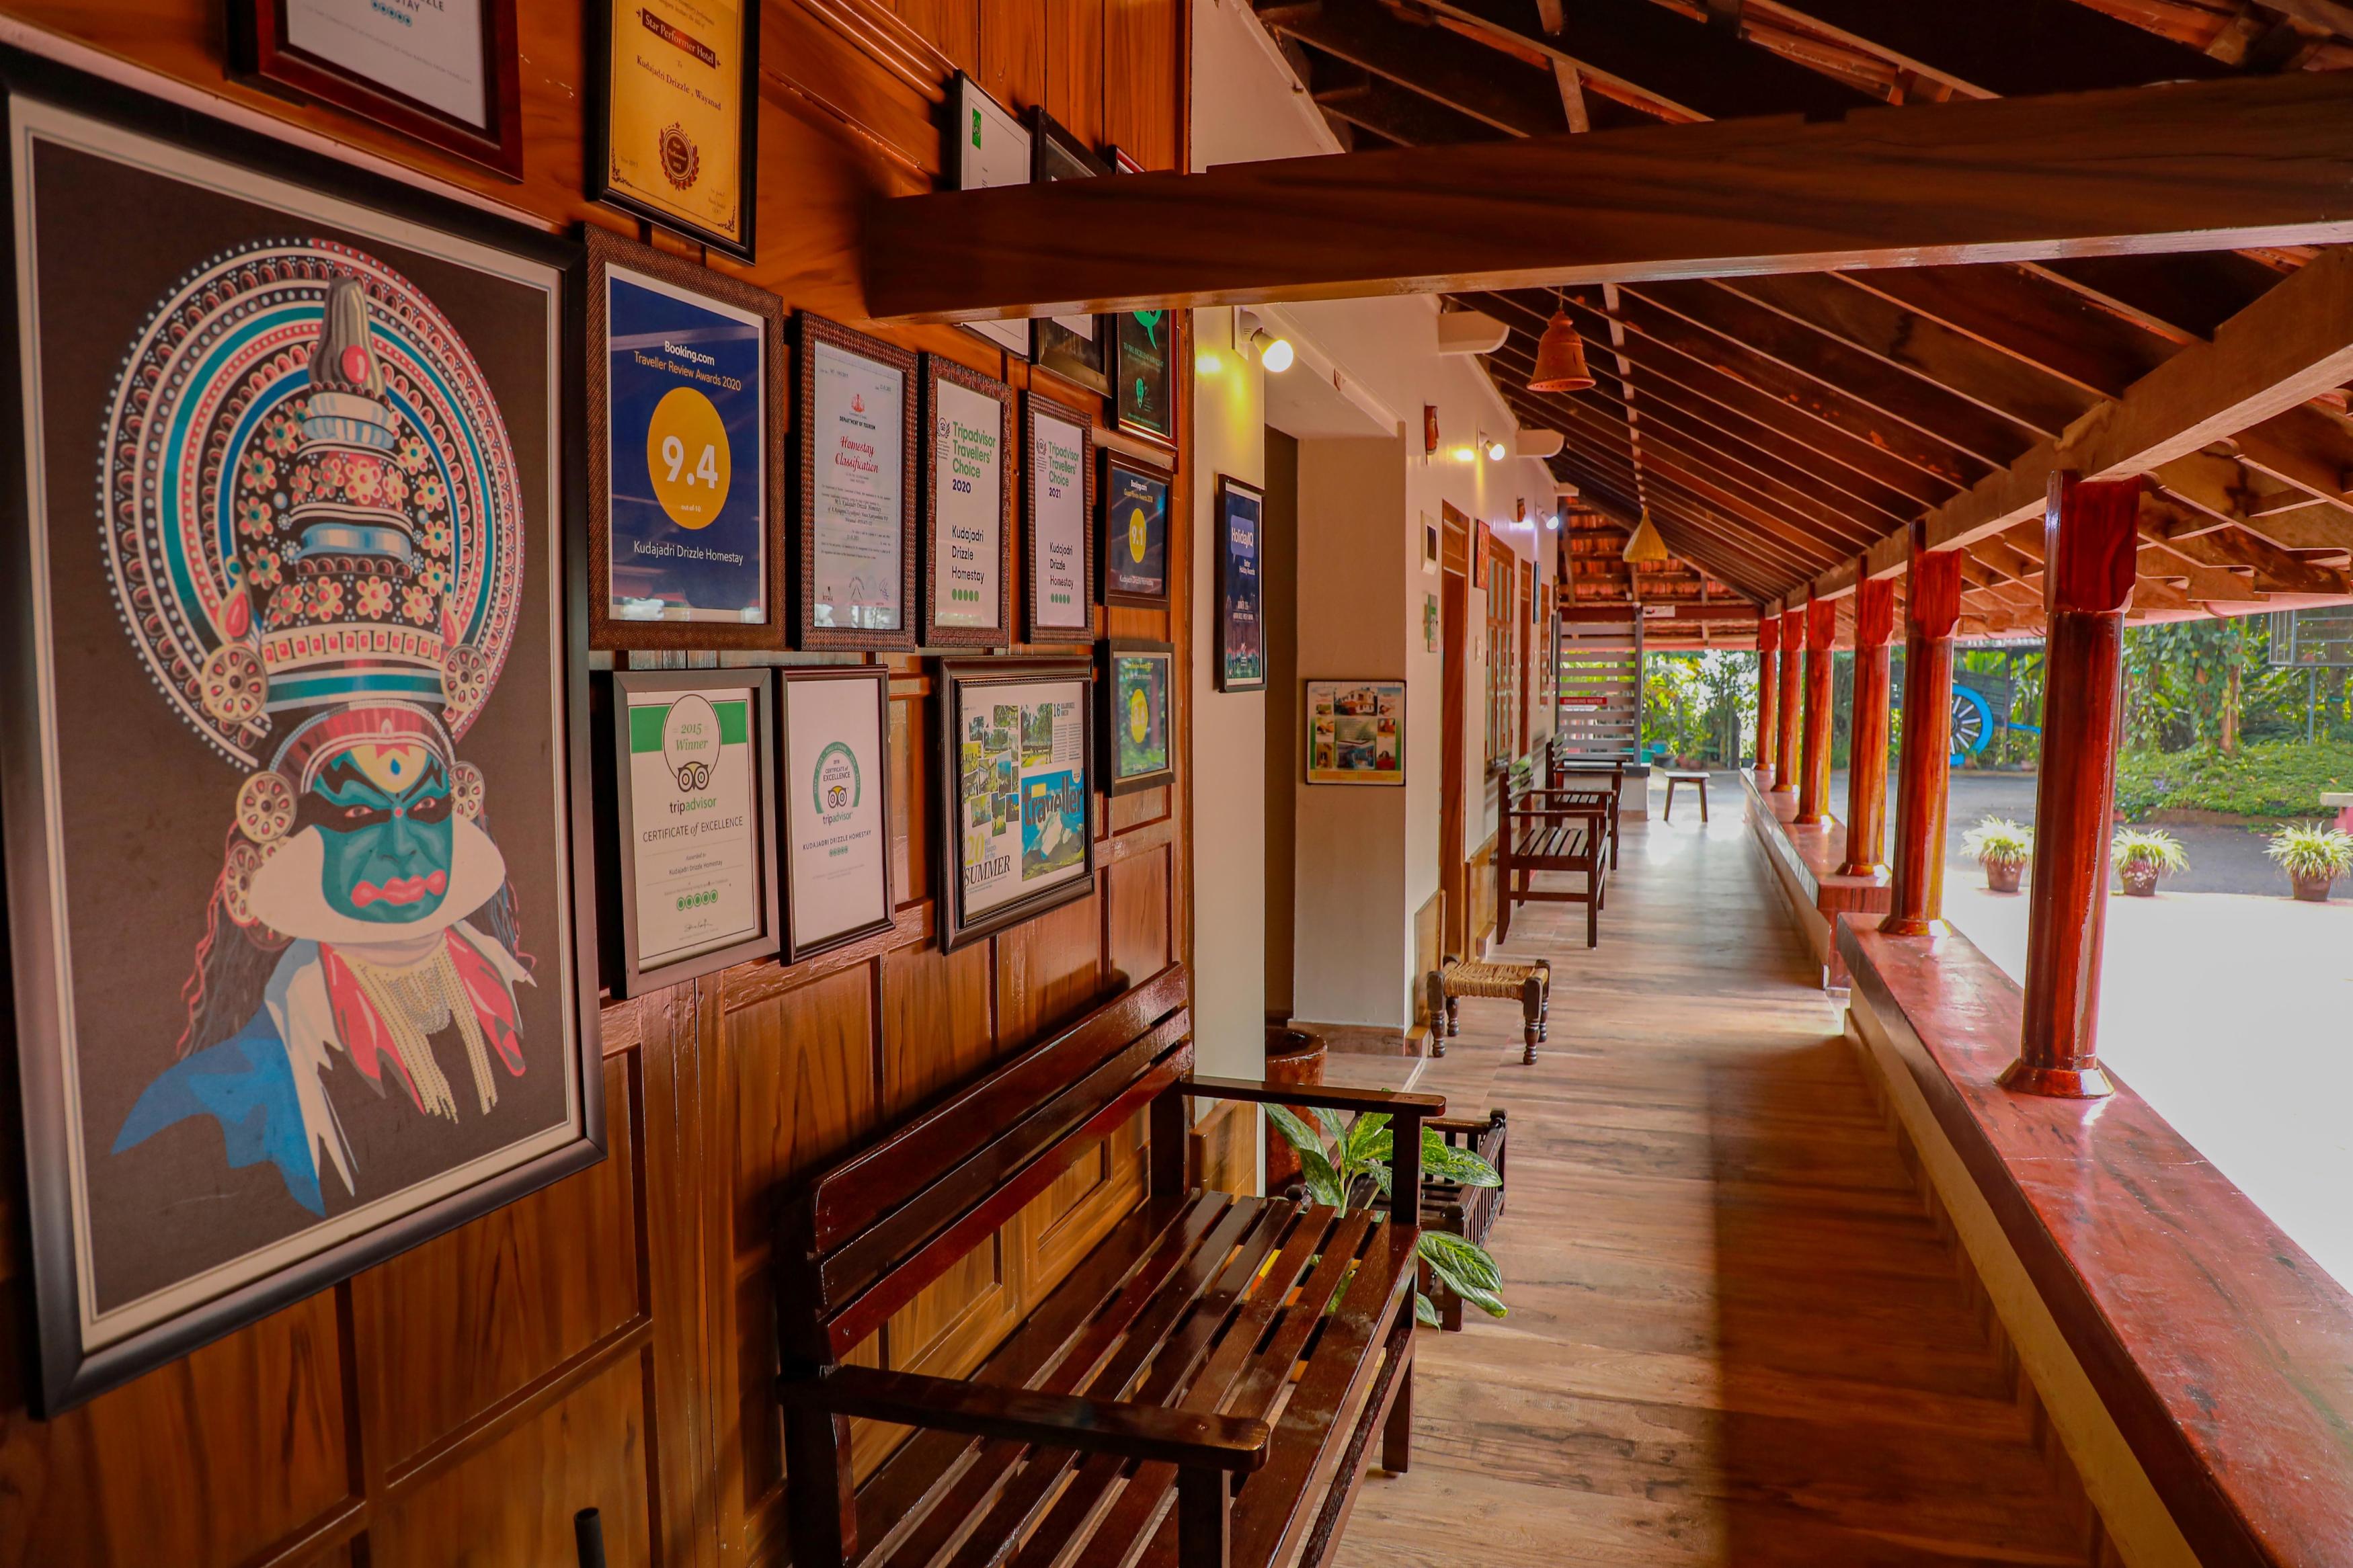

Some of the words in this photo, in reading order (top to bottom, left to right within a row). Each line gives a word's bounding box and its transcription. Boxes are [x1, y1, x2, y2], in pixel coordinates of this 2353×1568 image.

[645, 14, 659, 32] Star
[661, 24, 696, 52] Performer
[697, 45, 713, 65] Hotel
[637, 54, 665, 81] Kudajadri
[666, 74, 690, 94] Drizzle
[695, 89, 722, 111] Wayanad
[665, 340, 715, 366] Booking.com
[634, 350, 667, 370] Traveller
[668, 360, 694, 378] Review
[695, 369, 721, 386] Awards
[722, 376, 742, 392] 2020
[840, 416, 859, 426] DEPARTMENT
[863, 421, 876, 431] TOURISM
[953, 421, 996, 448] Tripadvisor
[840, 436, 875, 458] Homestay
[1049, 441, 1079, 462] Tripadvisor
[662, 436, 718, 489] 9.4
[835, 452, 879, 473] Classification
[953, 458, 980, 478] Choice
[953, 479, 971, 493] 2020
[1049, 470, 1069, 487] Choice
[1049, 487, 1061, 499] 2021
[952, 525, 984, 543] Kudajadri
[1132, 525, 1143, 545] 9.1
[1232, 527, 1254, 548] HolidayIQ
[634, 540, 675, 559] Kudajadri
[677, 545, 704, 560] Drizzle
[706, 548, 744, 567] Homestay
[952, 545, 973, 561] Drizzle
[1050, 542, 1073, 556] Kudajadri
[1050, 559, 1066, 571] Drizzle
[952, 566, 984, 584] Homestay
[1050, 575, 1074, 589] Homestay
[1053, 703, 1061, 717] 16
[681, 724, 703, 735] 2015
[676, 739, 708, 751] Winner
[824, 772, 850, 782] EXCELLENCE
[826, 766, 844, 774] CERTIFICATE
[670, 797, 717, 815] tripadvisor
[1021, 776, 1083, 827] traveller
[823, 812, 852, 826] tripadvisor
[643, 825, 688, 842] CERTIFICATE
[690, 822, 699, 836] of
[701, 816, 743, 832] EXCELLENCE
[803, 840, 829, 850] KUDAJADRI
[830, 835, 848, 845] DRIZZLE
[848, 830, 871, 839] HOMESTAY
[966, 833, 984, 866] 20
[669, 867, 689, 876] Kudajadri
[690, 863, 703, 872] Drizzle
[703, 860, 723, 868] Homestay
[964, 855, 1010, 887] SUMMER
